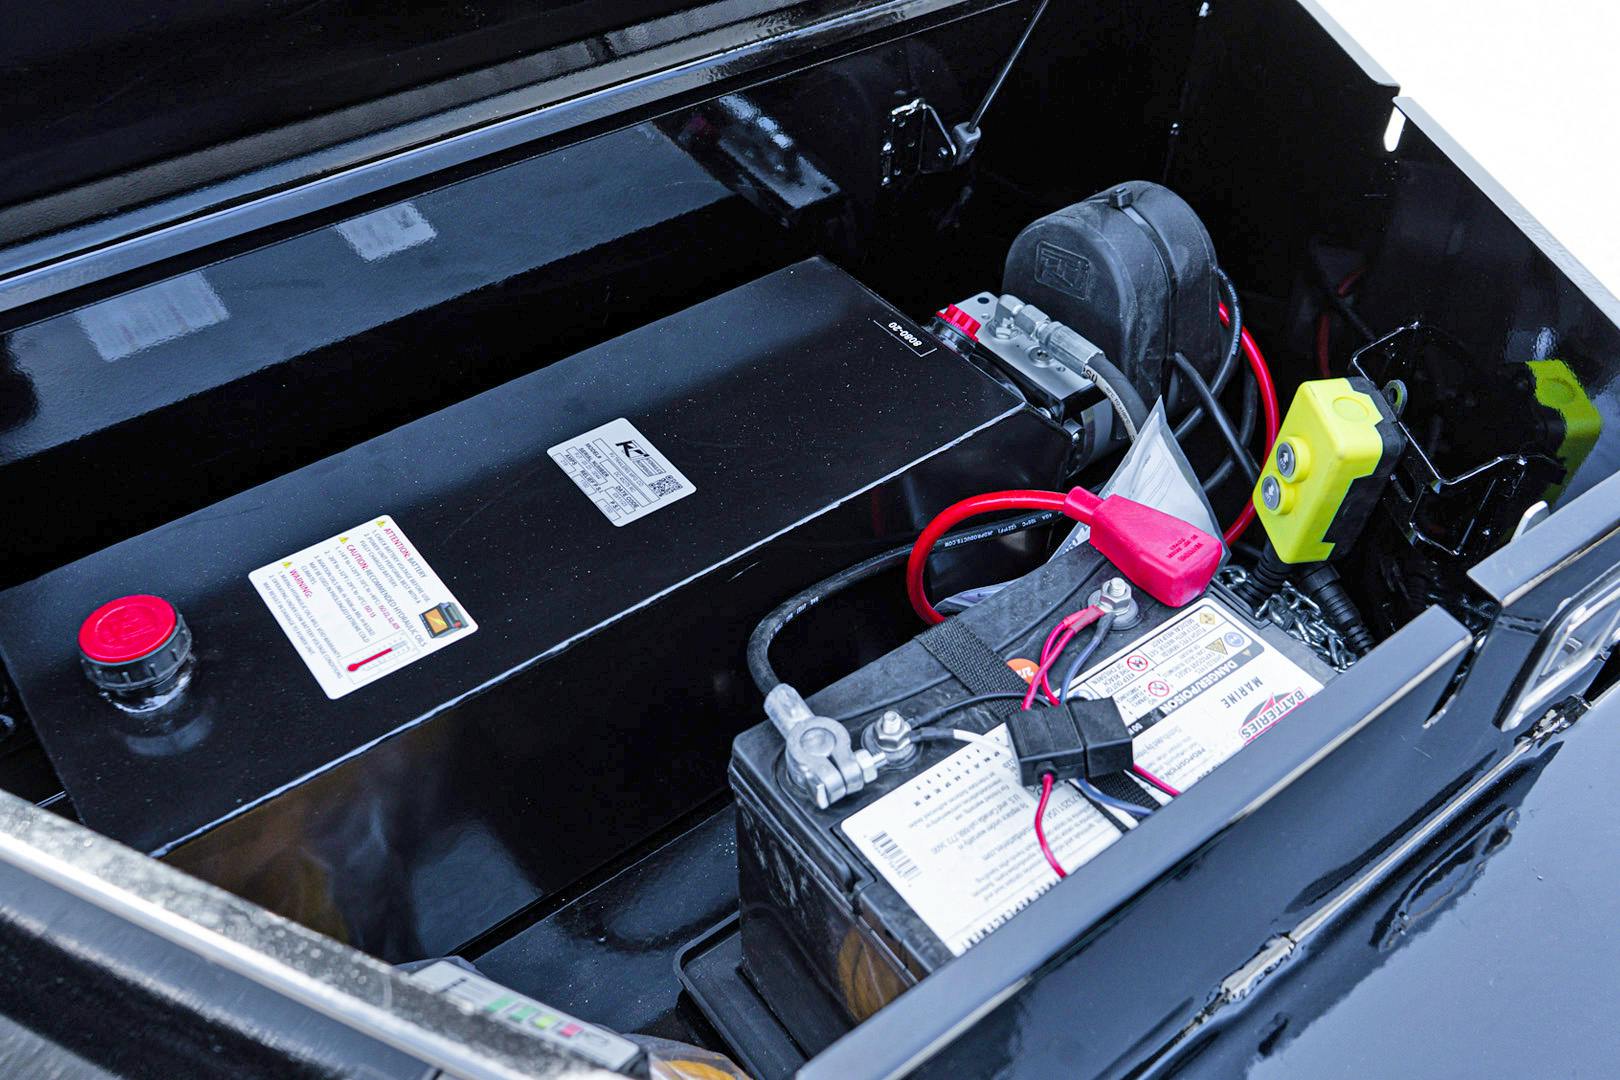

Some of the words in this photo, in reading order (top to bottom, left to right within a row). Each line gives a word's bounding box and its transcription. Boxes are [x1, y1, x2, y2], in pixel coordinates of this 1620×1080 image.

[590, 460, 610, 478] NUMBER
[614, 484, 629, 497] DATE
[381, 526, 413, 559] ATTENTION:
[405, 555, 429, 579] BATTERY
[383, 545, 401, 563] BATTERY
[287, 568, 314, 599] WARNING:
[344, 542, 371, 571] CAUTION:
[363, 567, 399, 608] RECOMMENDED
[391, 605, 420, 636] HYDRAULIC
[411, 632, 429, 648] OILS
[1157, 658, 1239, 715] DANGER/POISON
[1217, 674, 1265, 709] MARINE
[1237, 688, 1307, 740] BATTERIES
[1163, 746, 1206, 778] PROPOSITION
